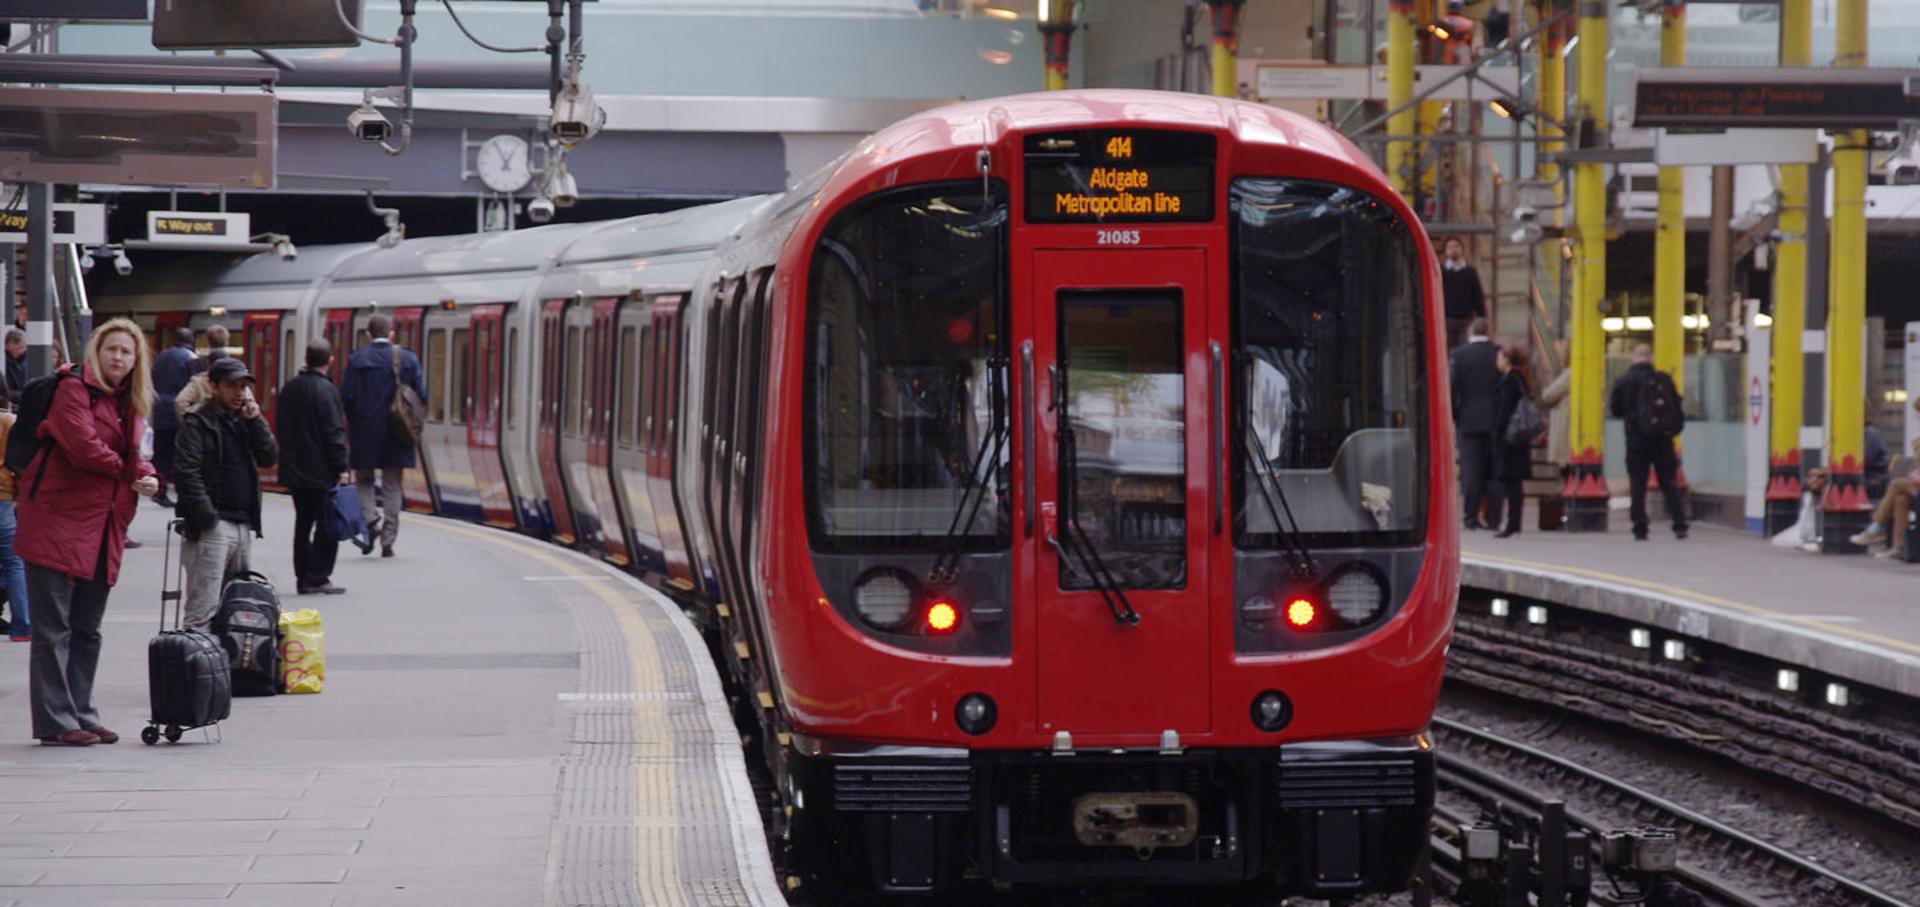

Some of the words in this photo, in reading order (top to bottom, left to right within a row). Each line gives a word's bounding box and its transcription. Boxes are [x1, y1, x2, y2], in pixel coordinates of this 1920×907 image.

[1106, 136, 1132, 158] 414
[1089, 167, 1149, 191] Aldgate
[1056, 192, 1152, 217] Metropolitan
[1154, 192, 1181, 213] line
[168, 220, 193, 233] Way
[193, 222, 214, 232] out
[1097, 230, 1141, 245] 21083
